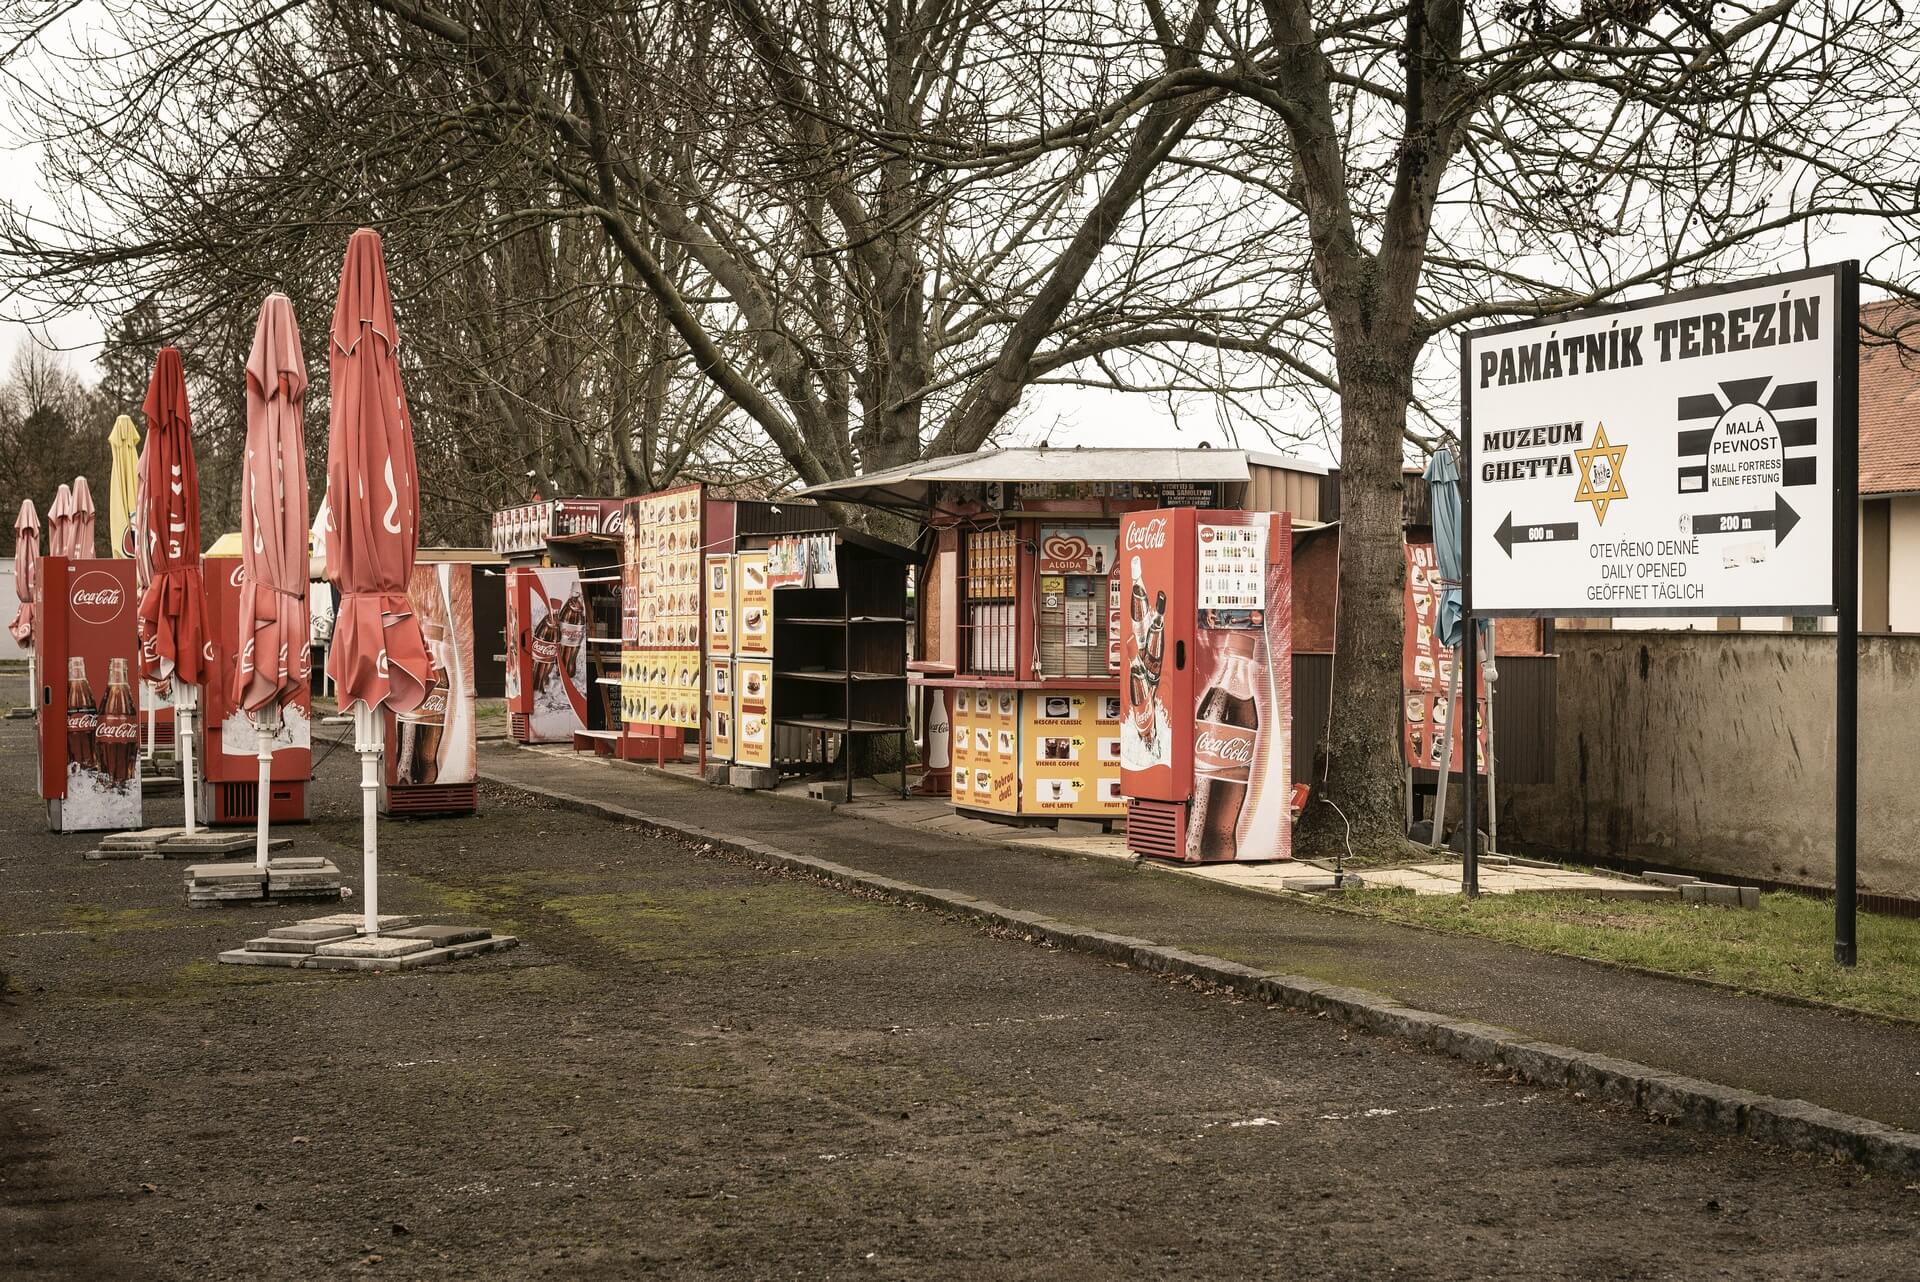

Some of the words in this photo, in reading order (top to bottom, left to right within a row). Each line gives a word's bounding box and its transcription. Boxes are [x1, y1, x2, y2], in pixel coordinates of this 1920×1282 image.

[1480, 319, 1644, 389] PAMÁTNÍK
[1653, 289, 1821, 363] TEREZÍN
[1726, 416, 1765, 436] MALÁ
[1482, 421, 1585, 453] MUZEUM
[1713, 436, 1778, 454] PEVNOST
[1481, 454, 1574, 483] GHETTA
[1710, 463, 1736, 474] SMALL
[1738, 459, 1782, 472] FORTRESS
[1711, 476, 1740, 487] KLEINE
[1741, 473, 1780, 485] FESTUNG
[1719, 515, 1740, 531] 200
[1741, 518, 1752, 530] m
[1528, 527, 1544, 541] 600
[1545, 529, 1554, 540] m
[1589, 538, 1654, 558] OTEVŘENO
[1657, 535, 1700, 556] DENNĚ
[1048, 561, 1082, 569] ALGIDA
[1601, 563, 1634, 579] DAILY
[1636, 562, 1687, 578] OPENED
[1586, 582, 1649, 601] GEÖFFNET
[1651, 581, 1704, 599] TÄGLICH
